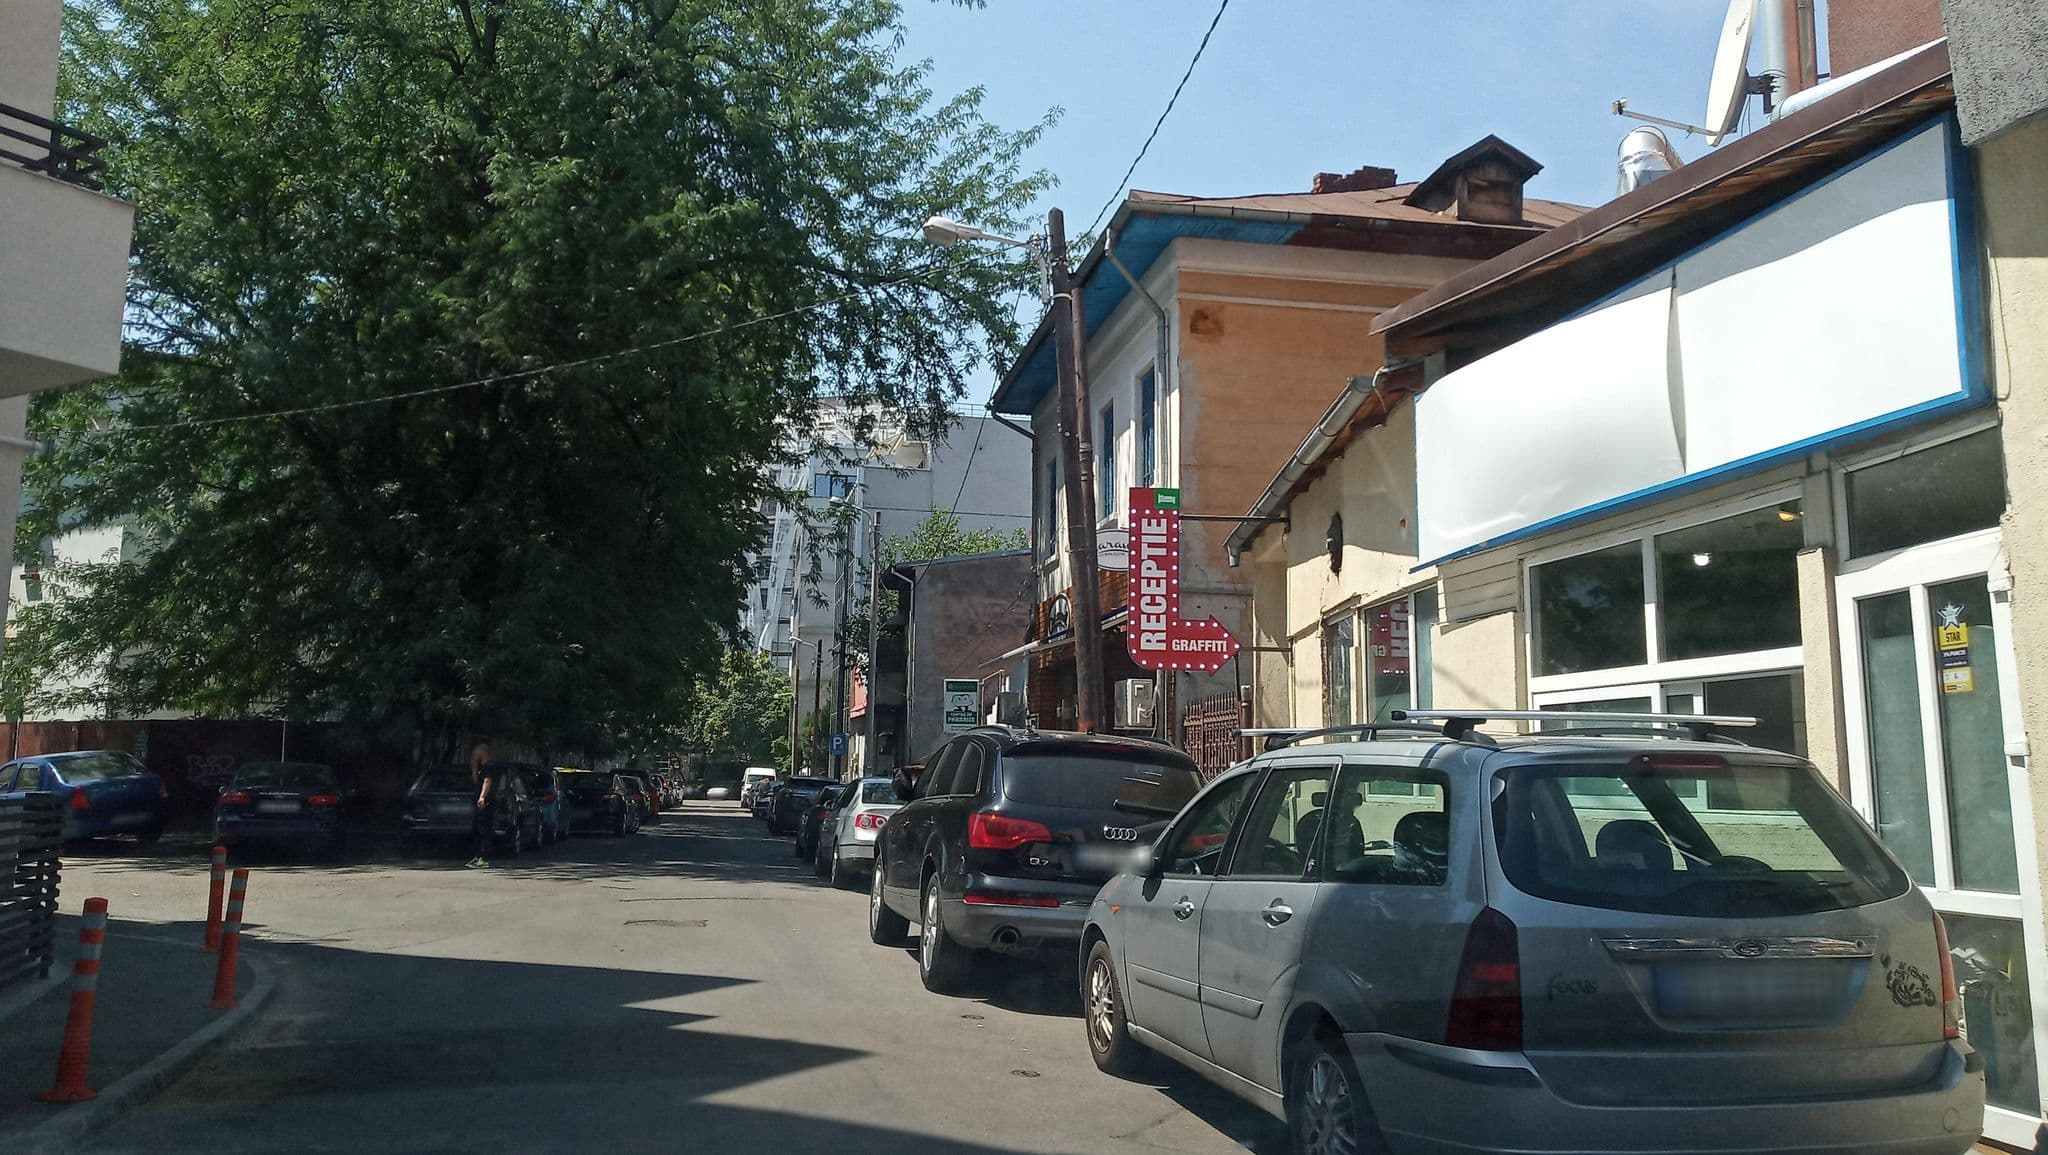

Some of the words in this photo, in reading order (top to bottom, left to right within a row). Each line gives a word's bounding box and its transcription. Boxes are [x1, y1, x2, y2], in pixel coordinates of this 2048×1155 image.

[1140, 518, 1168, 651] RECEPTIE
[1945, 631, 1961, 643] STAR
[1171, 639, 1228, 652] GRAFFITI
[833, 736, 842, 750] P
[1029, 857, 1049, 866] Q7
